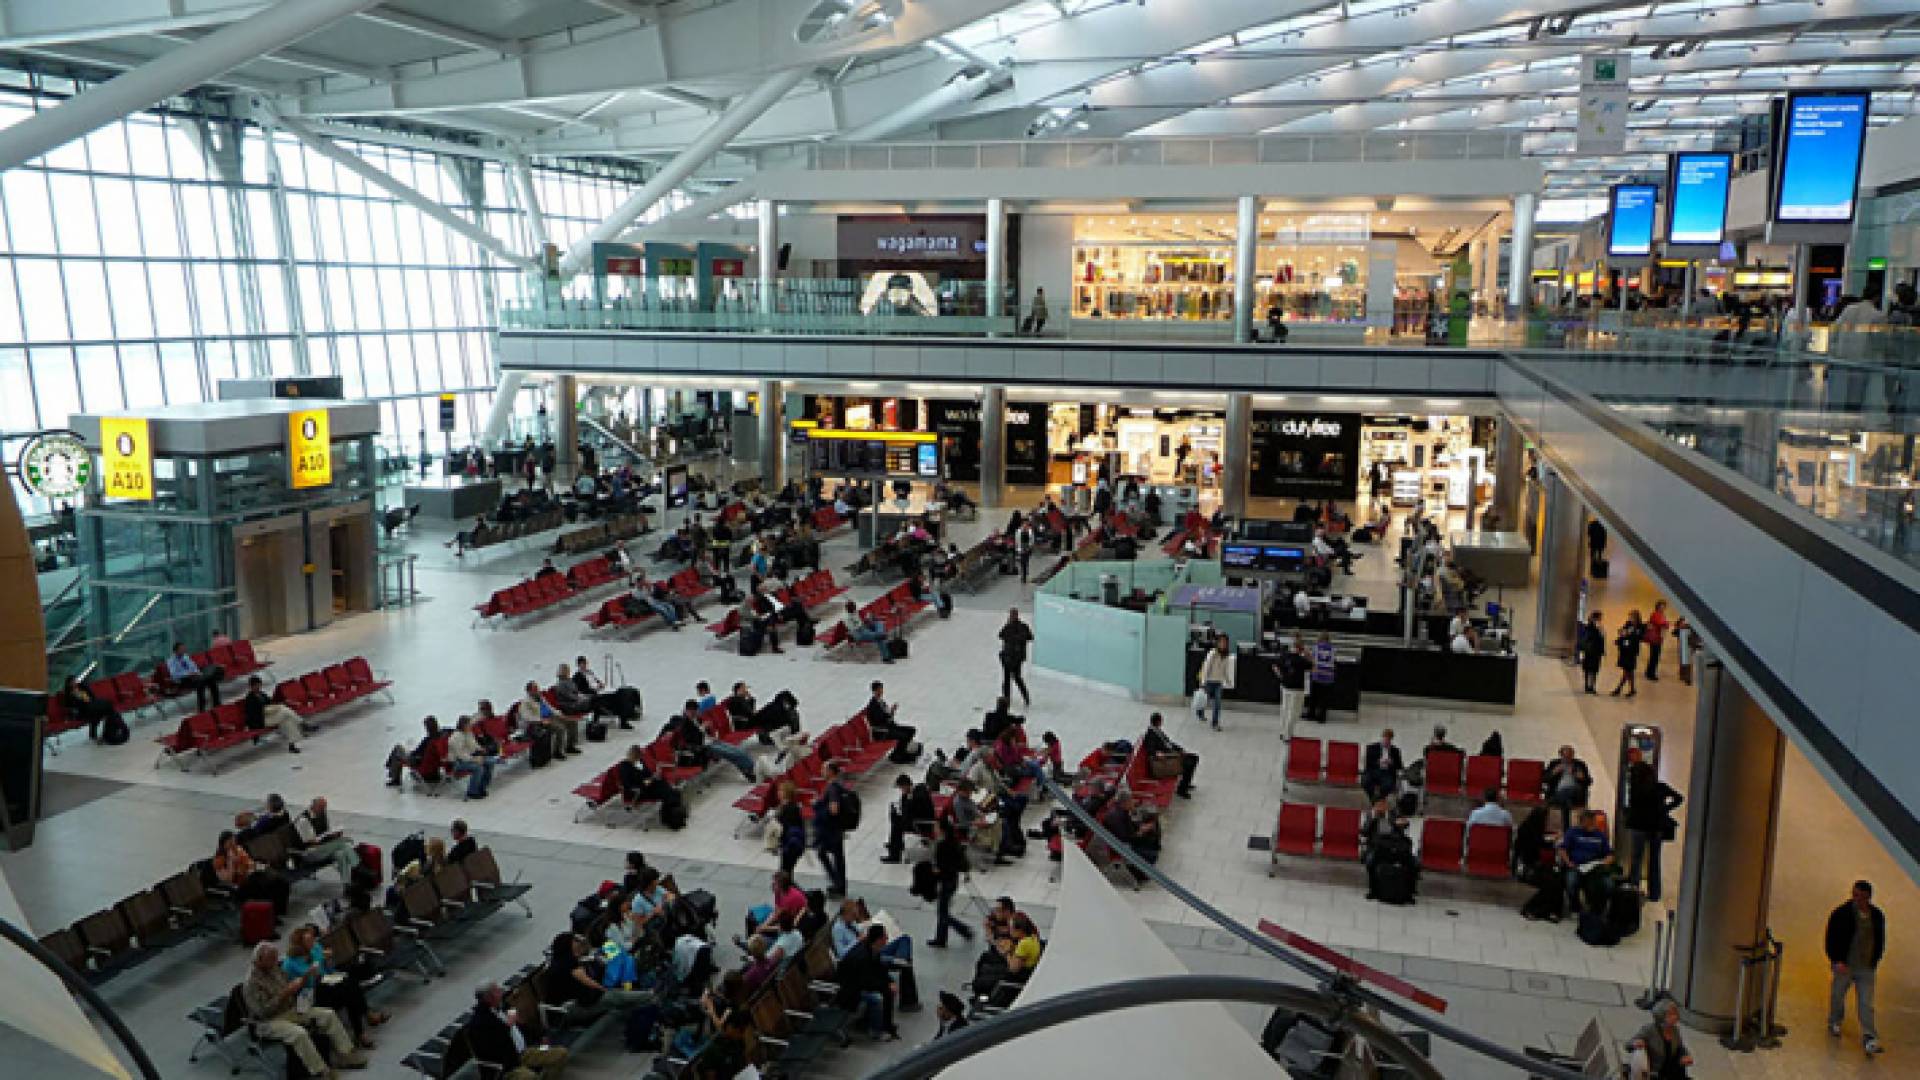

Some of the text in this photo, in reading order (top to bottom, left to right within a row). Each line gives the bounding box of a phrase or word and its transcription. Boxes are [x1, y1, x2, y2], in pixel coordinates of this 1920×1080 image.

[877, 236, 958, 254] wagamama
[296, 453, 325, 473] A10
[112, 471, 144, 490] A10
